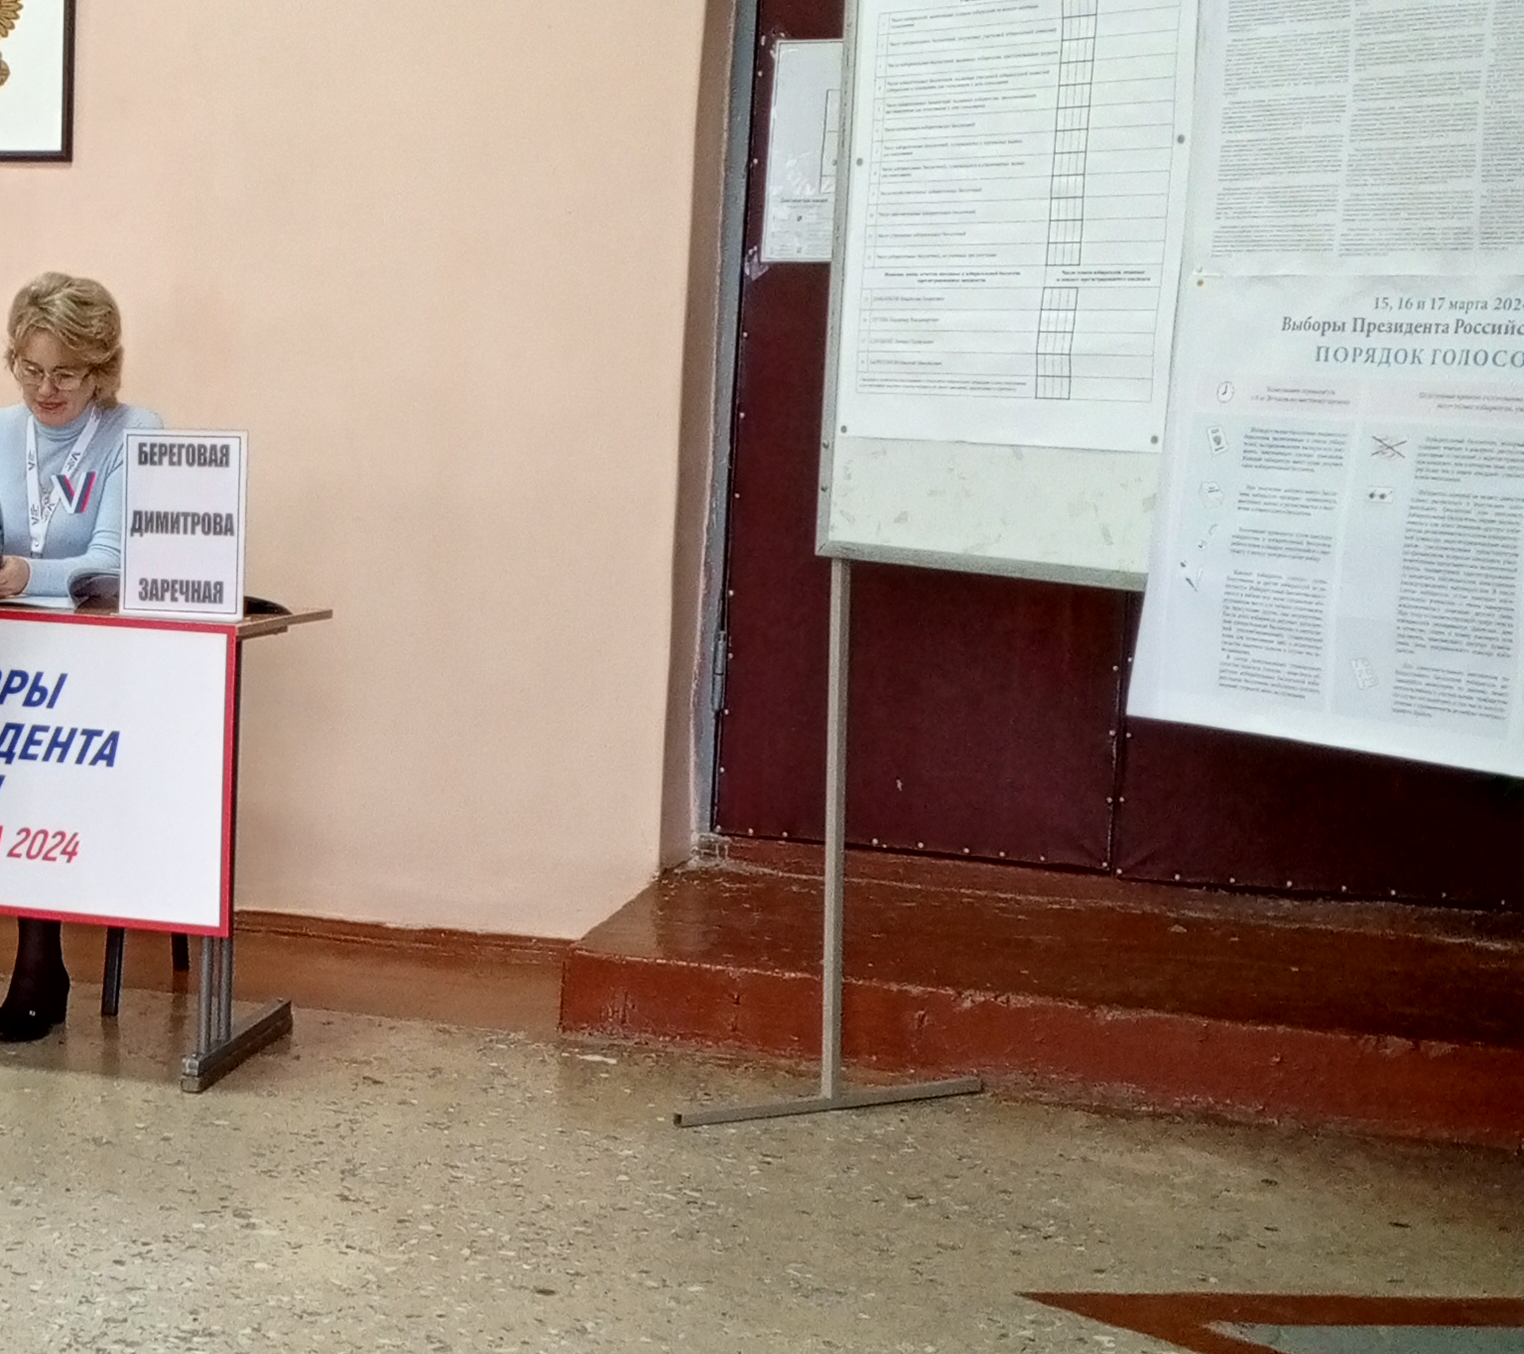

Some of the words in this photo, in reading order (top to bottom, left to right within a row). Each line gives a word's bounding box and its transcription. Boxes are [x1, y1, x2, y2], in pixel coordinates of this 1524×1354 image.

[1374, 296, 1393, 312] 15,
[1398, 298, 1413, 311] 16
[1416, 300, 1426, 310] и
[1430, 297, 1446, 311] 17
[1448, 301, 1488, 314] марта
[1493, 297, 1524, 311] 202
[1281, 316, 1346, 337] Выборы
[1352, 317, 1450, 337] Президента
[1315, 346, 1425, 368] ПОРЯДОК
[137, 442, 231, 468] БЕРЕГОВАЯ
[129, 509, 235, 537] ДИМИТРОВА
[138, 577, 224, 605] ЗАРЕЧНАЯ
[7, 827, 81, 864] 2024
